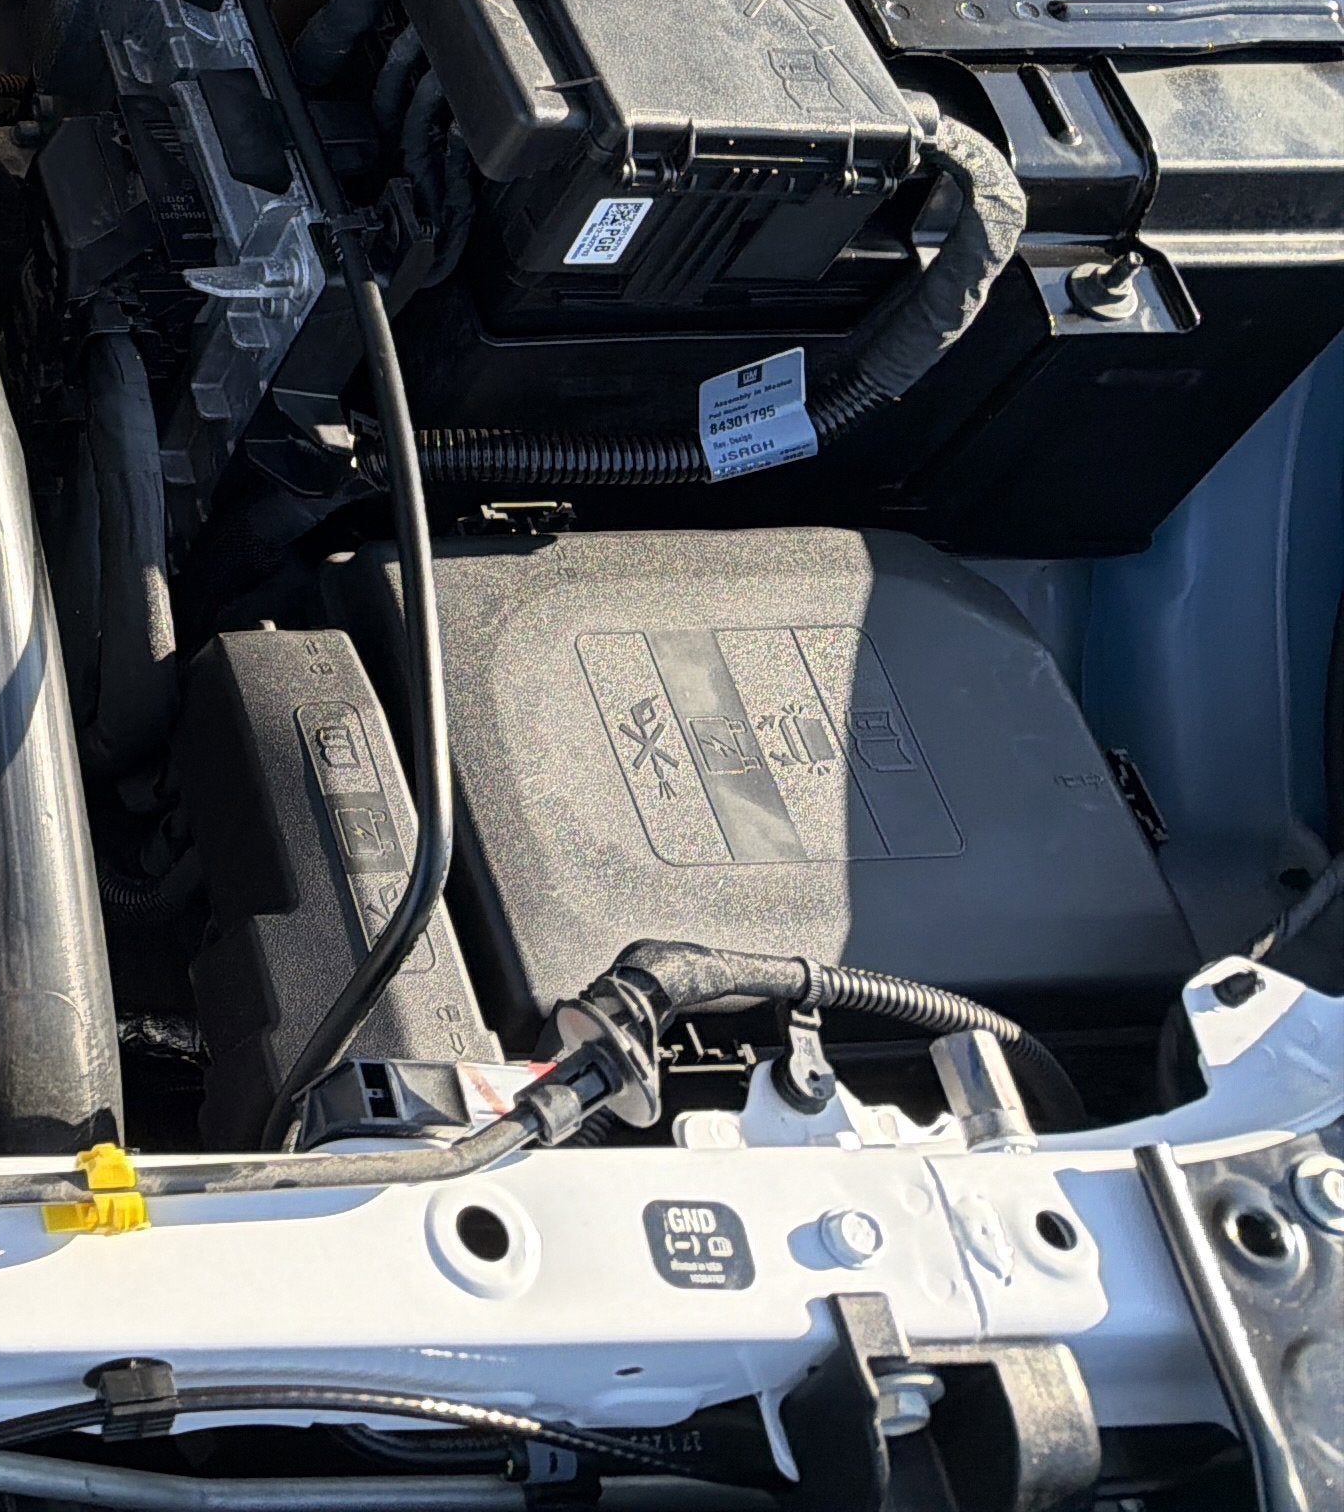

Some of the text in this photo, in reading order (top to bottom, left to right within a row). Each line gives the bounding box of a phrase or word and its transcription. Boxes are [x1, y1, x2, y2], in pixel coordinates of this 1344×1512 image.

[594, 228, 621, 252] PGB
[714, 392, 751, 408] Assembly
[709, 405, 776, 436] 84301795
[718, 440, 775, 464] JSRGH
[667, 1207, 716, 1234] GND
